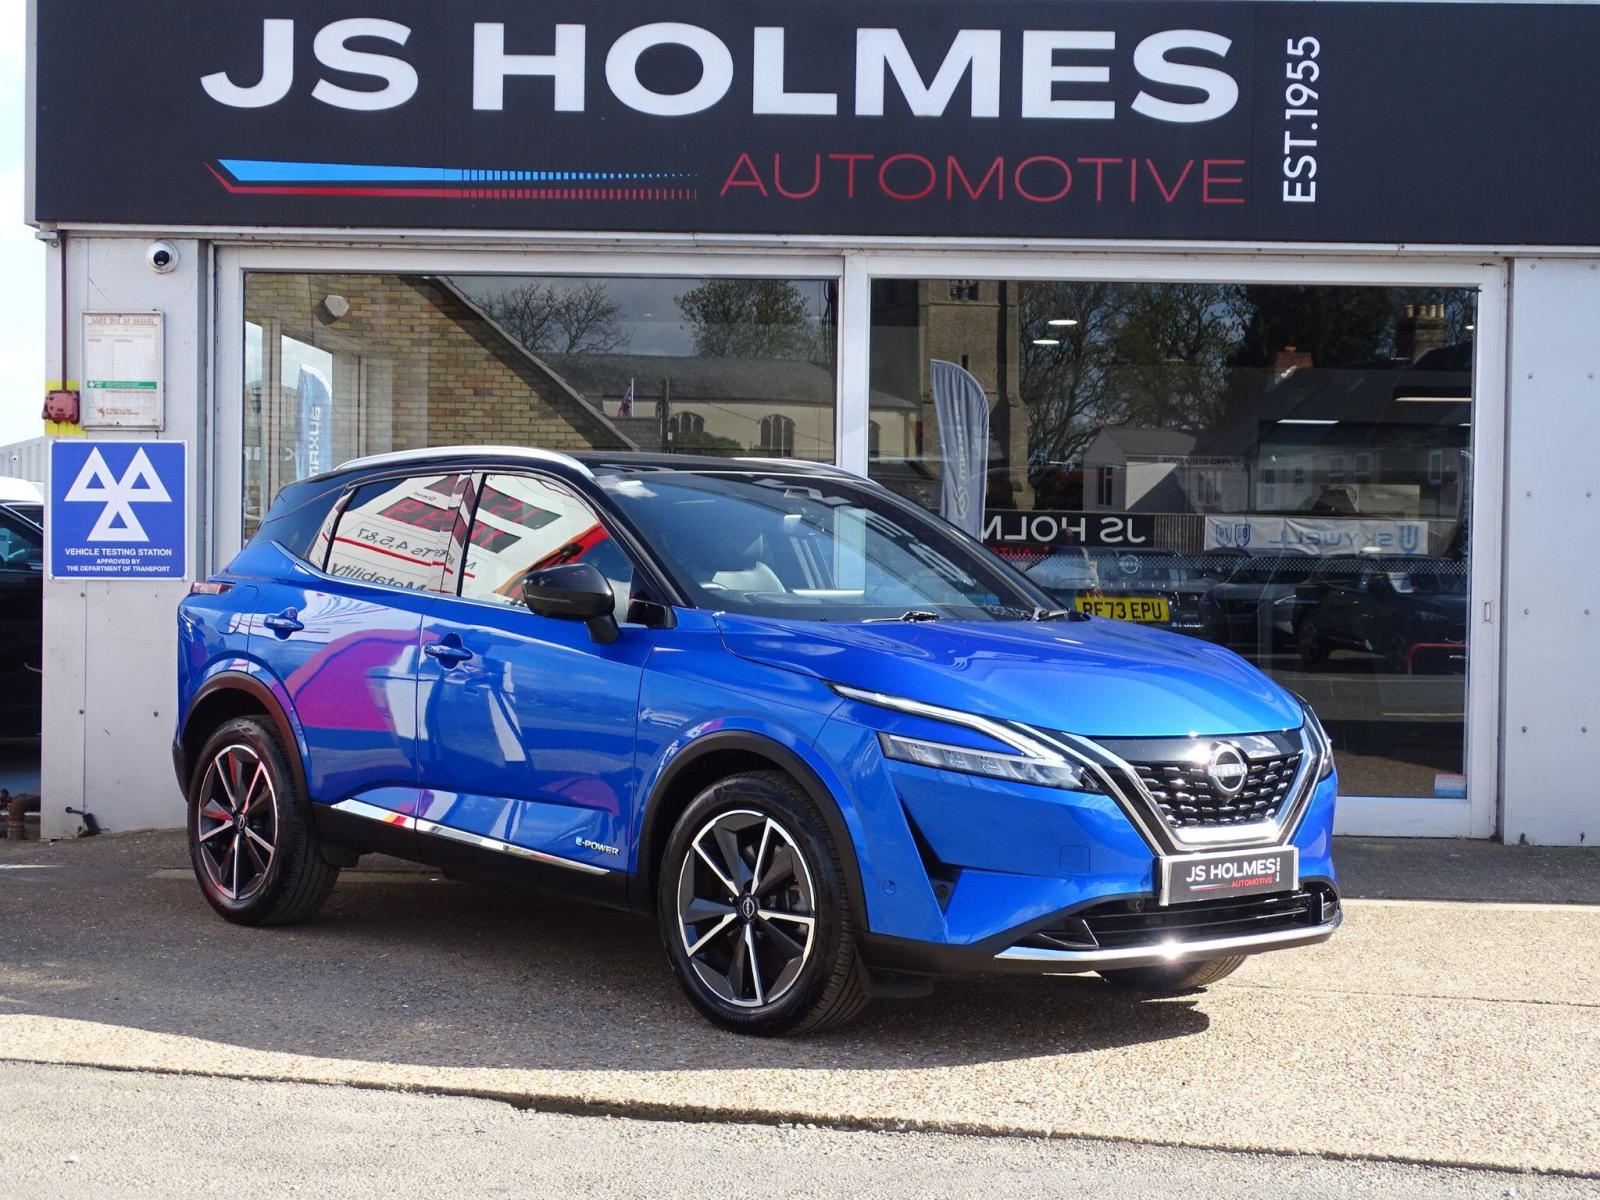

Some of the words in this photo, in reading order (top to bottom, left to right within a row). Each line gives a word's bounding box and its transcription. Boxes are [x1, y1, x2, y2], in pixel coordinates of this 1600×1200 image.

[201, 18, 418, 110] JS
[473, 23, 1239, 122] HOLMES
[1283, 36, 1321, 203] EST.1955
[719, 153, 1246, 206] AUTOMOTIVE
[65, 547, 99, 556] VEHICLE
[101, 548, 136, 556] TESTING
[138, 548, 172, 556] STATION
[1130, 602, 1163, 620] EPU
[1185, 865, 1207, 883] JS
[1210, 858, 1276, 880] HOLMES
[1231, 876, 1274, 888] AUTOMOTIVE
